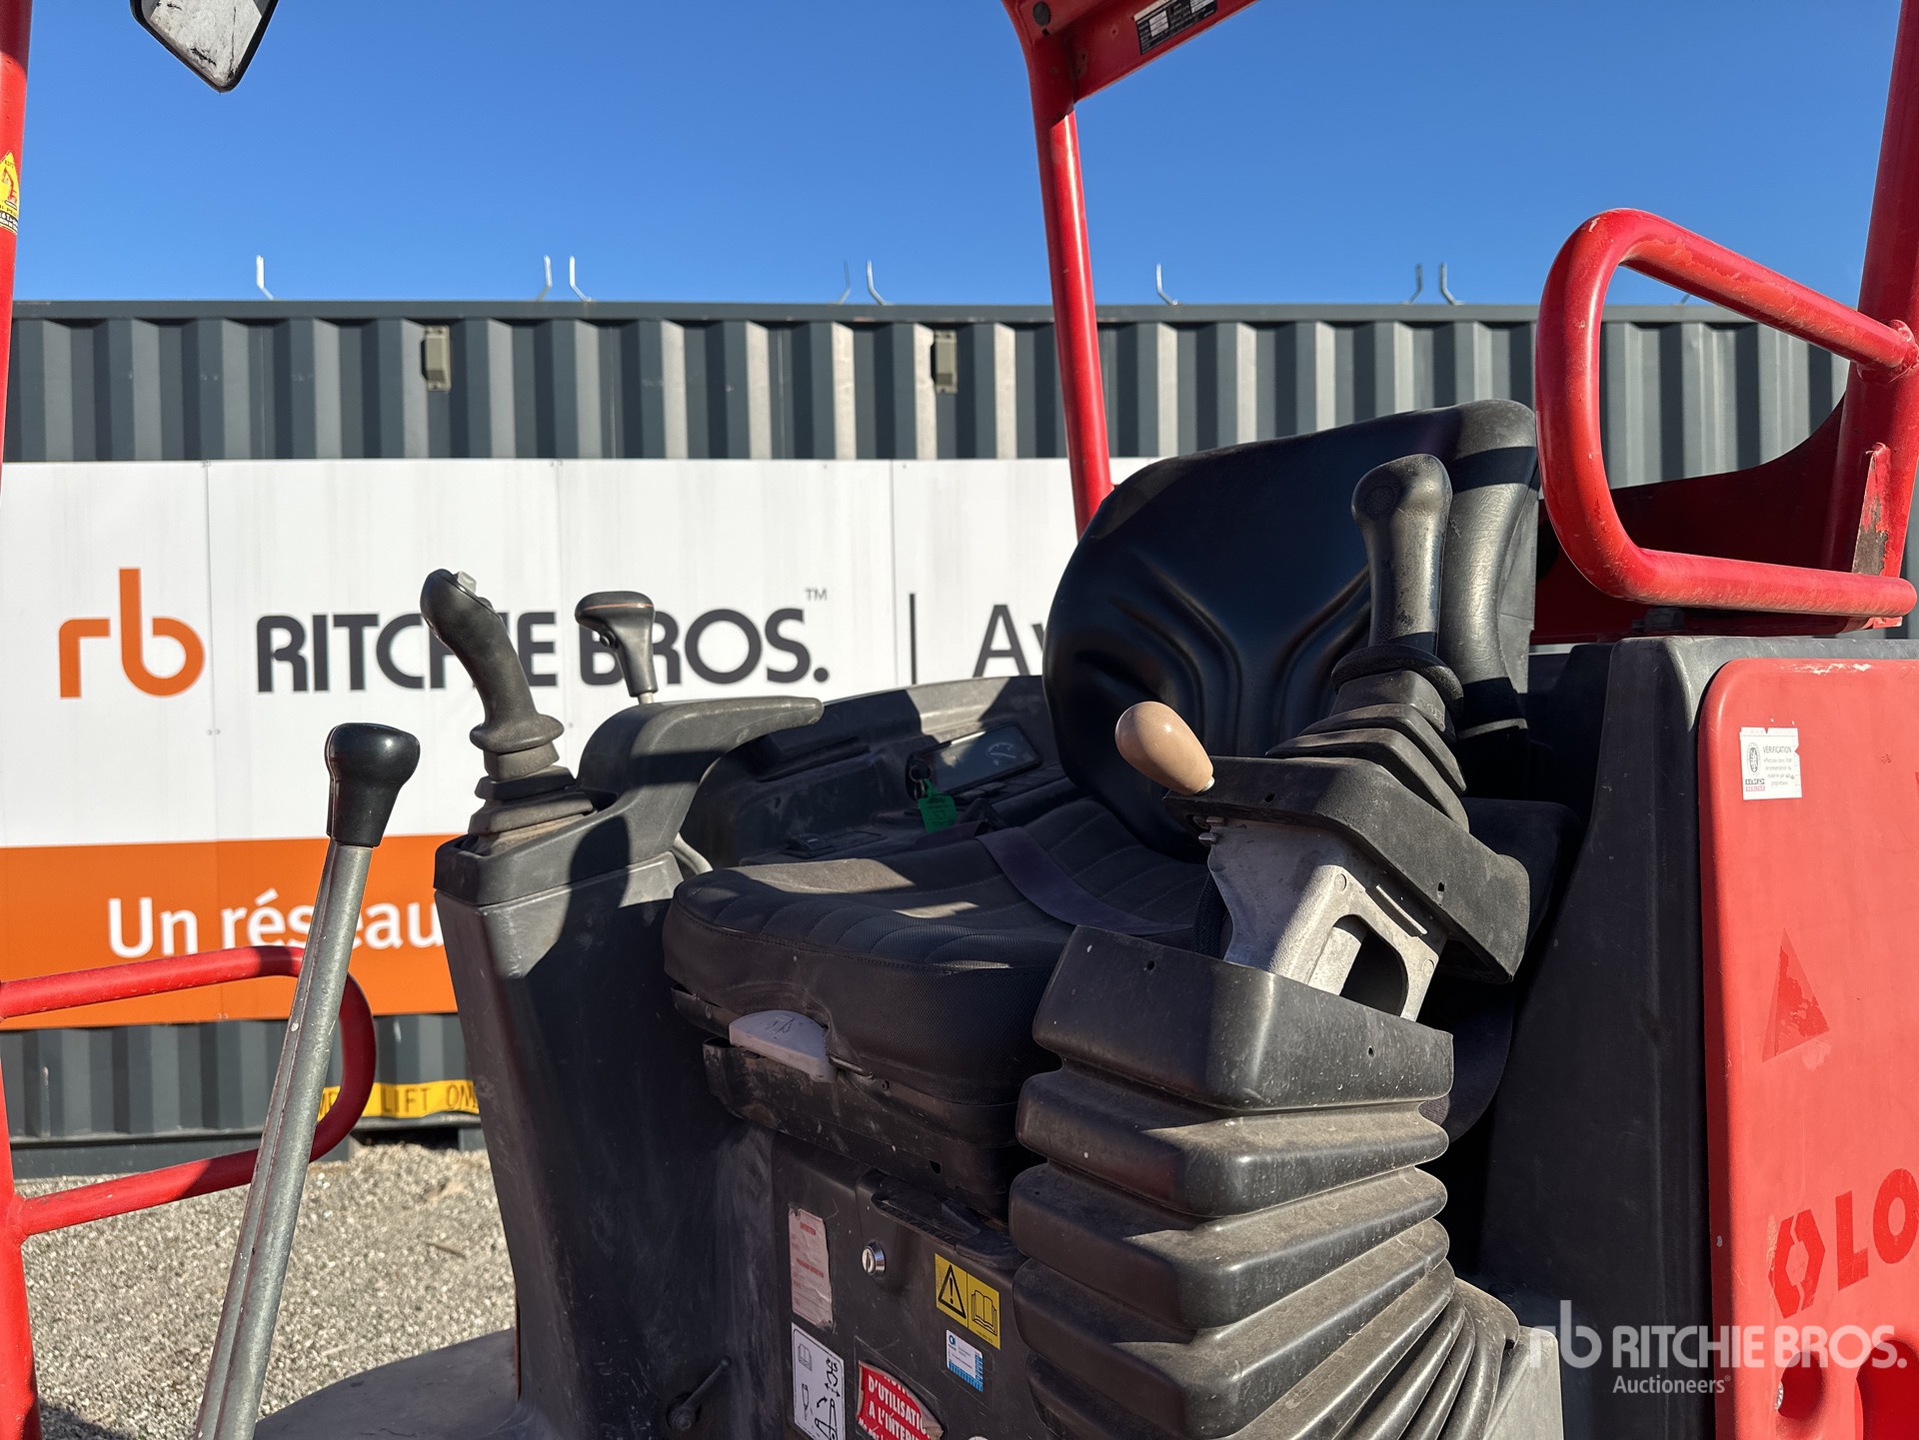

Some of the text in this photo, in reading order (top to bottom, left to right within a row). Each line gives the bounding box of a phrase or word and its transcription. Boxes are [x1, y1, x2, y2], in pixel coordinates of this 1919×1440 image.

[256, 611, 558, 692] RITCE
[107, 887, 446, 958] Un résau
[380, 1084, 476, 1113] LIFT ON
